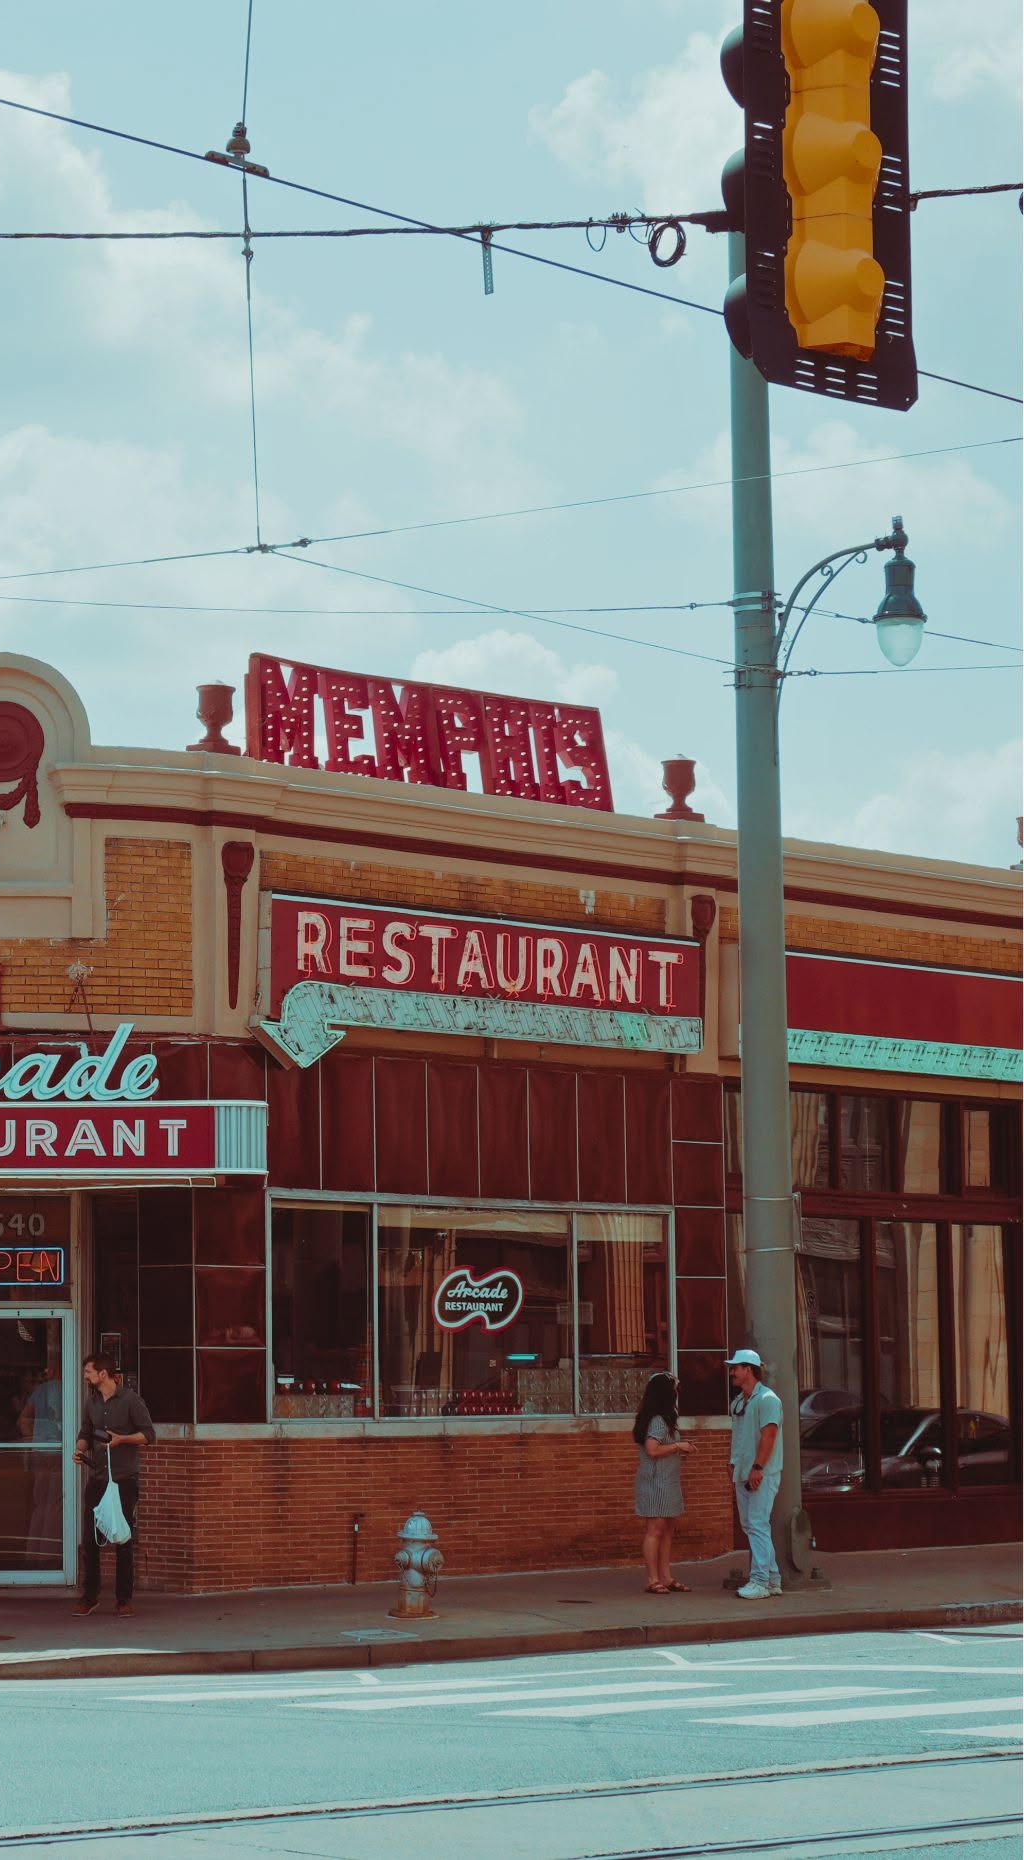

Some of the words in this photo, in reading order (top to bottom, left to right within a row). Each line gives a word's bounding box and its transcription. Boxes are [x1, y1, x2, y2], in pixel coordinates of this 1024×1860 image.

[257, 658, 613, 812] MEMPHIS
[296, 911, 684, 1012] RESTAURANT
[444, 1301, 504, 1312] RESTAURANT
[447, 1280, 510, 1299] Arcade
